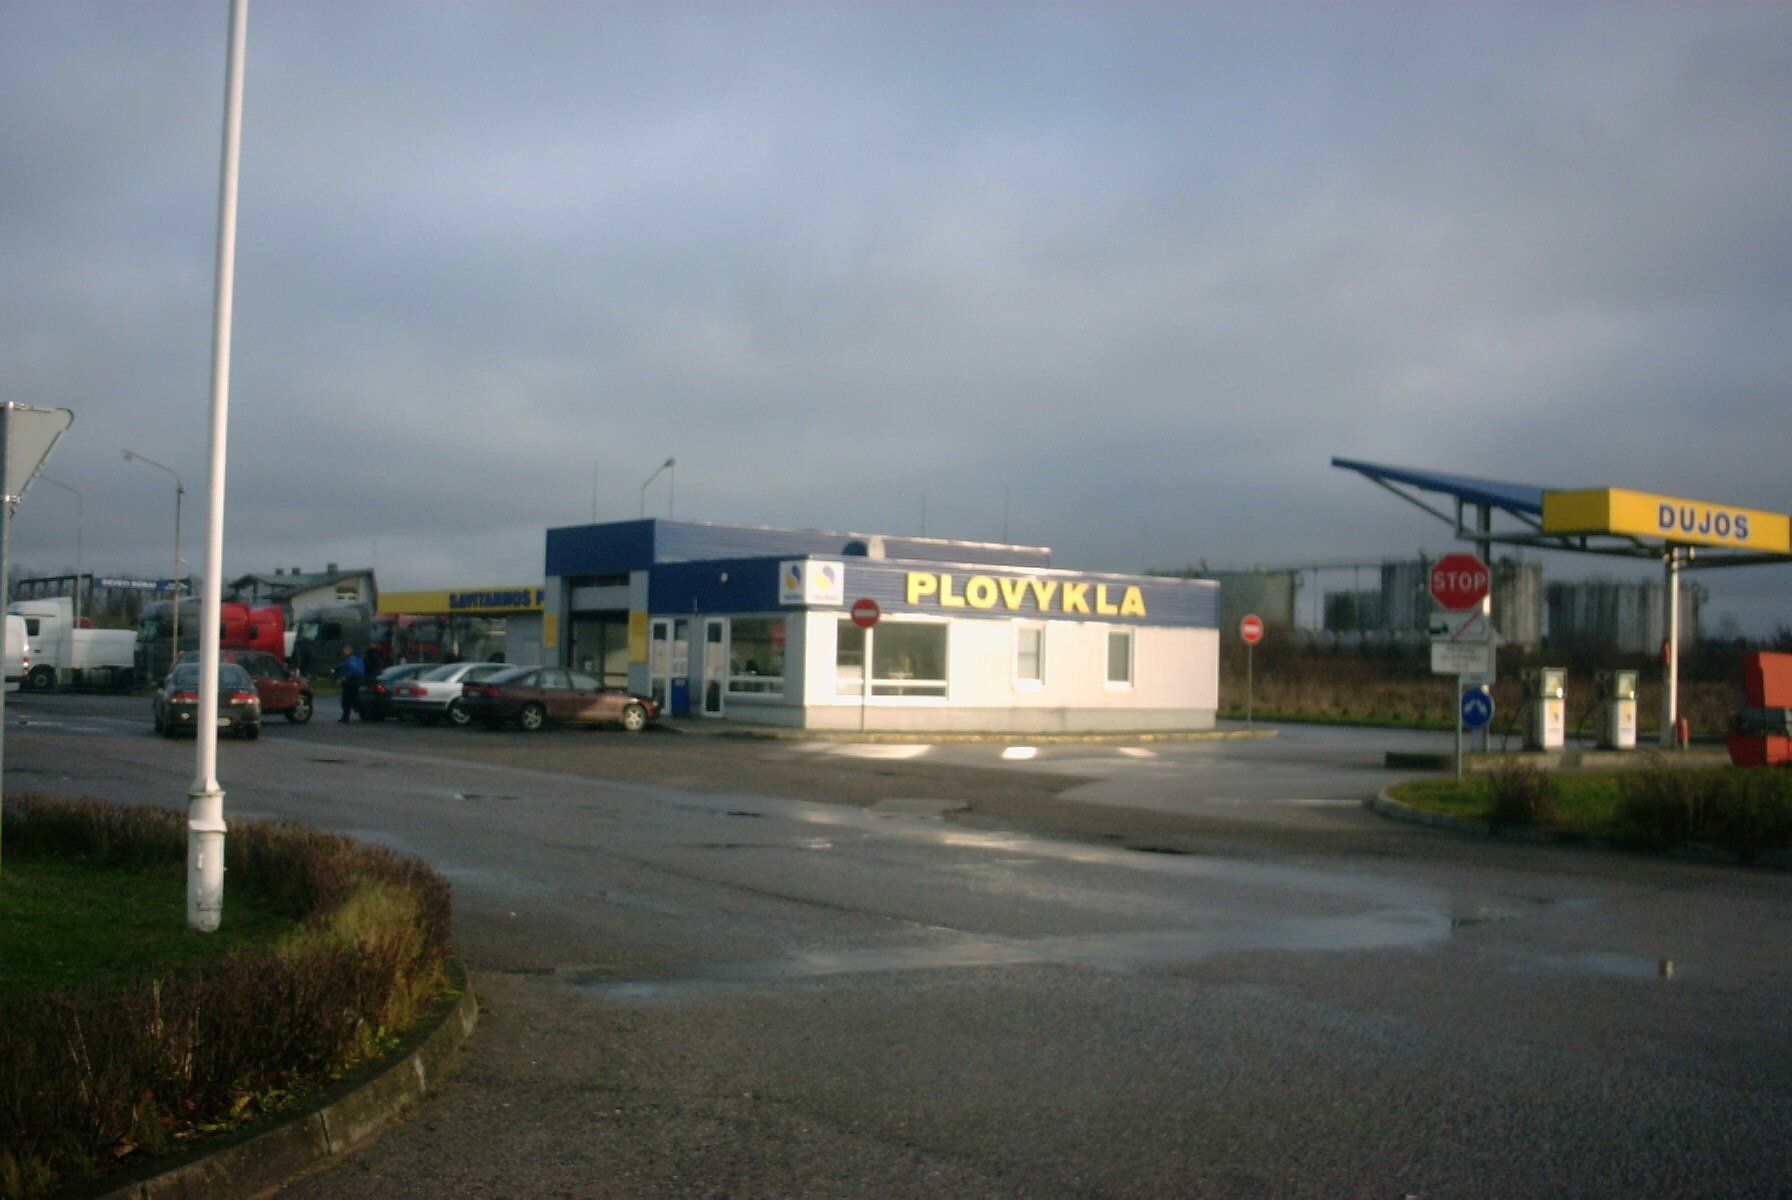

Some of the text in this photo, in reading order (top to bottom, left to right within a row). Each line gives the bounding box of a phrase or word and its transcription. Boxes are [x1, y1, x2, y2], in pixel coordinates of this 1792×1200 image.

[1658, 503, 1749, 540] DUJOS
[905, 571, 1147, 618] PLOVYKLA
[1433, 571, 1487, 592] STOP
